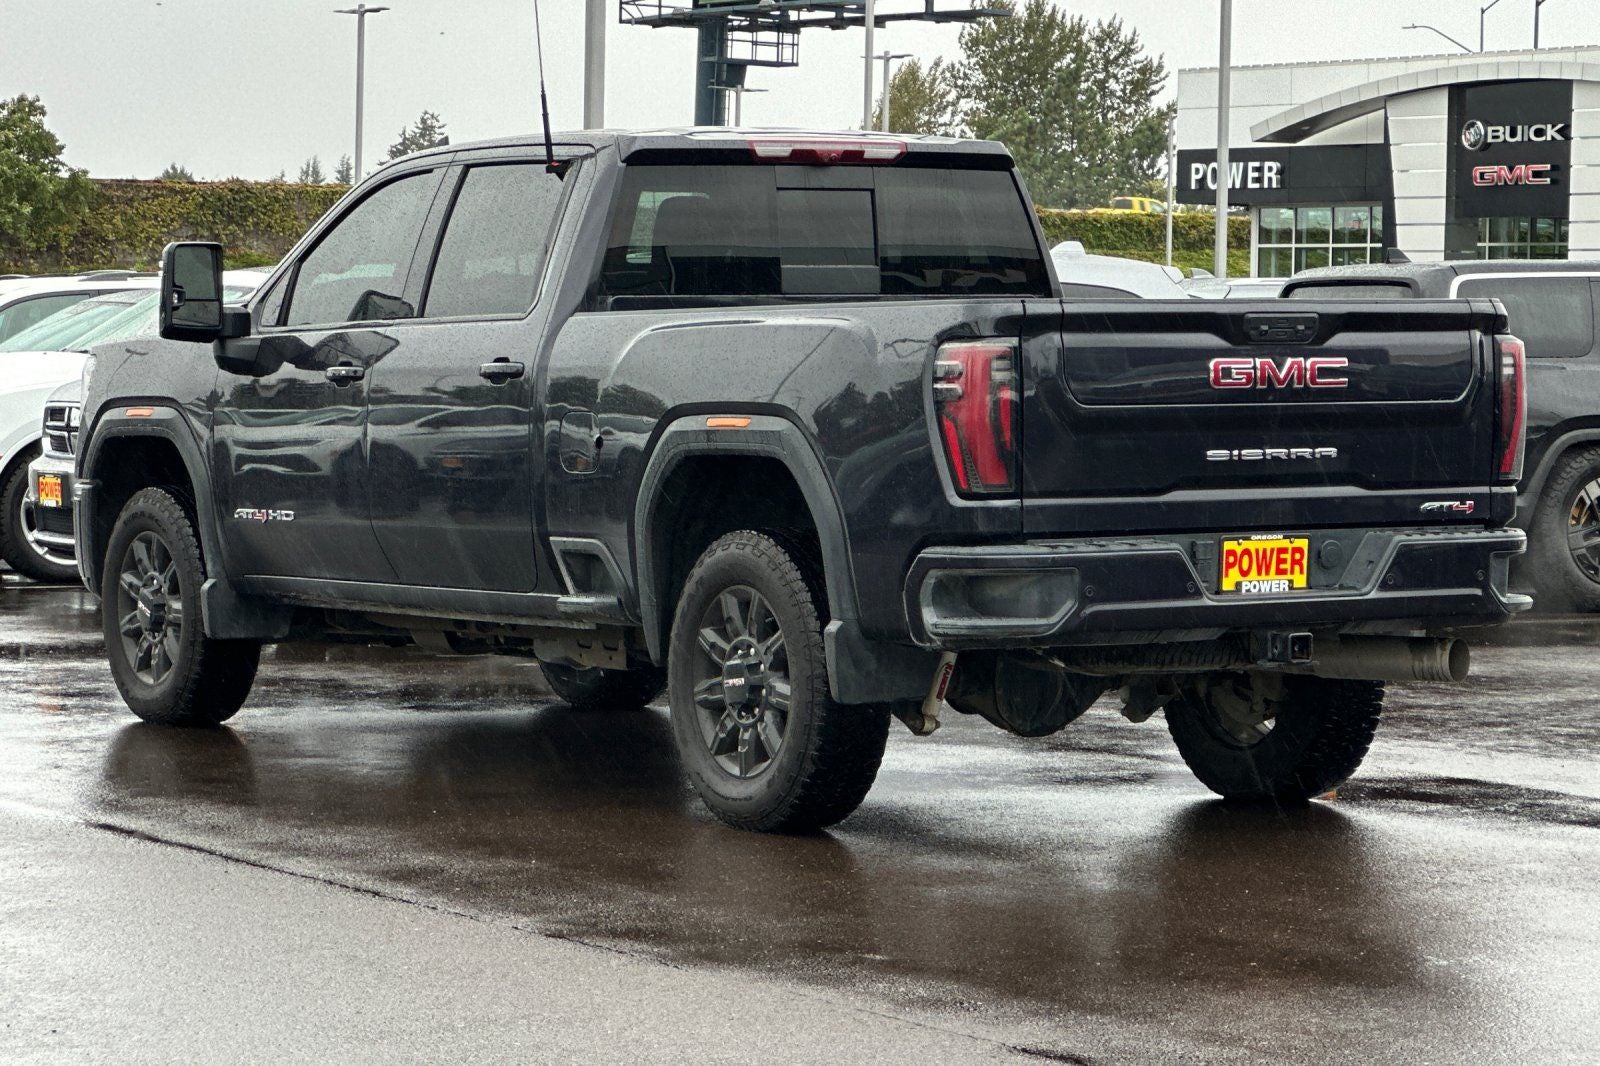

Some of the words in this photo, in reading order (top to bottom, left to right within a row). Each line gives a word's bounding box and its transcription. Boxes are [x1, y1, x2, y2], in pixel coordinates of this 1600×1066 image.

[1487, 123, 1565, 143] BUICK
[1190, 161, 1281, 190] POWER
[1472, 163, 1551, 187] GMC
[1208, 357, 1349, 389] GMC
[1206, 447, 1338, 461] SIERRA
[1223, 546, 1305, 578] POWER
[1241, 580, 1289, 594] POWER
